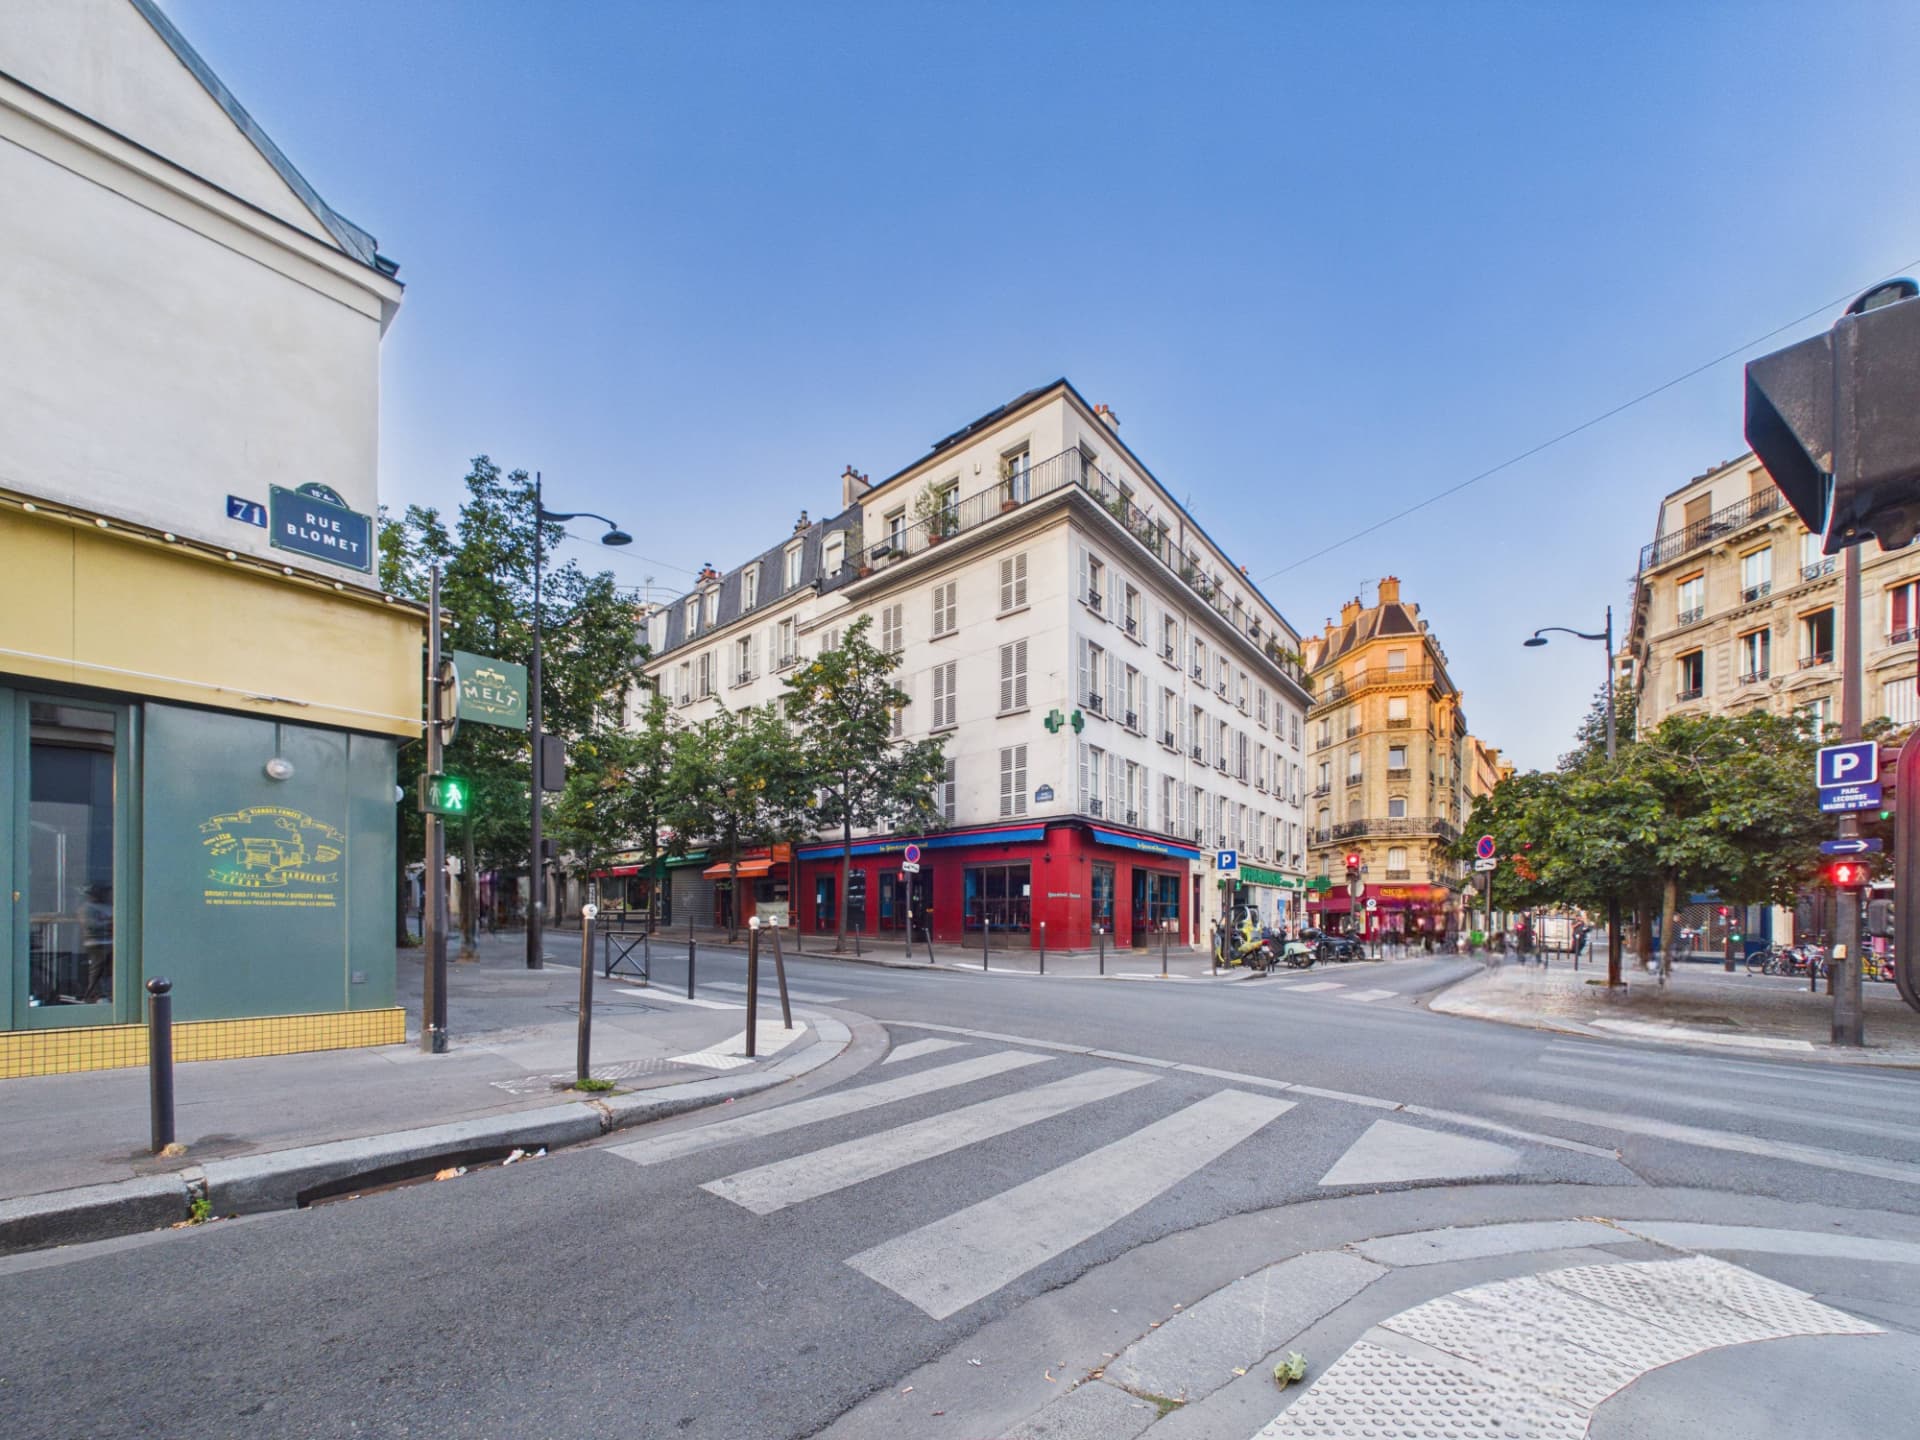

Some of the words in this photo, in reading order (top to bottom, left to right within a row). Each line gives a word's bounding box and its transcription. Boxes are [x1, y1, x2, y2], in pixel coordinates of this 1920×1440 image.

[232, 499, 263, 525] 71
[305, 512, 341, 533] RUE
[287, 523, 359, 553] BLOMET
[464, 686, 517, 706] MELT
[1833, 752, 1860, 779] P
[1222, 853, 1232, 868] P
